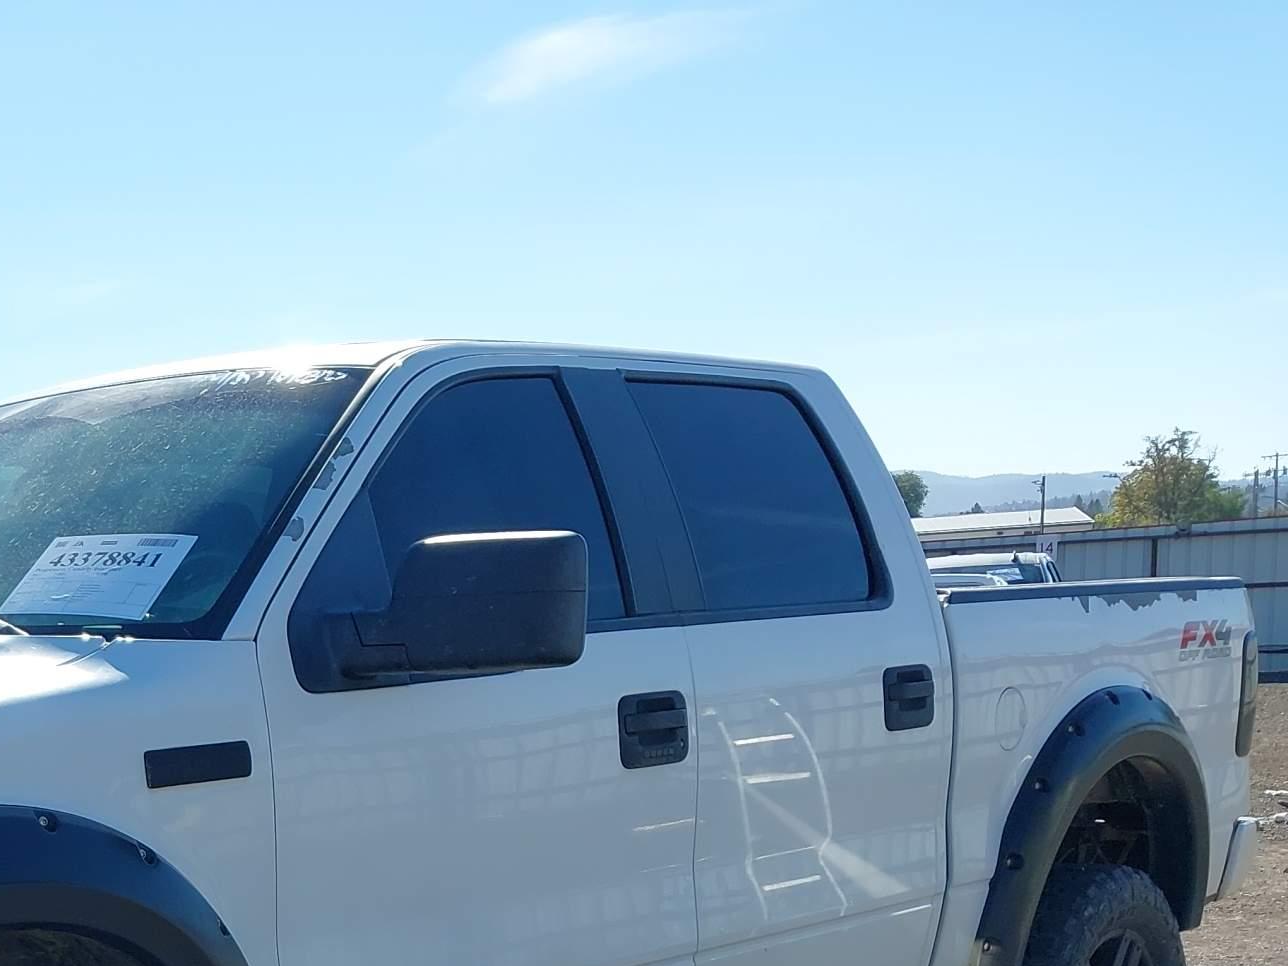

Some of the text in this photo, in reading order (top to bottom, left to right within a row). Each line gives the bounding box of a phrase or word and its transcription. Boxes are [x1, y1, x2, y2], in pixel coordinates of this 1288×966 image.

[49, 552, 163, 568] 43378841
[1179, 618, 1233, 650] FX4
[1178, 646, 1233, 662] OFF ROAD
